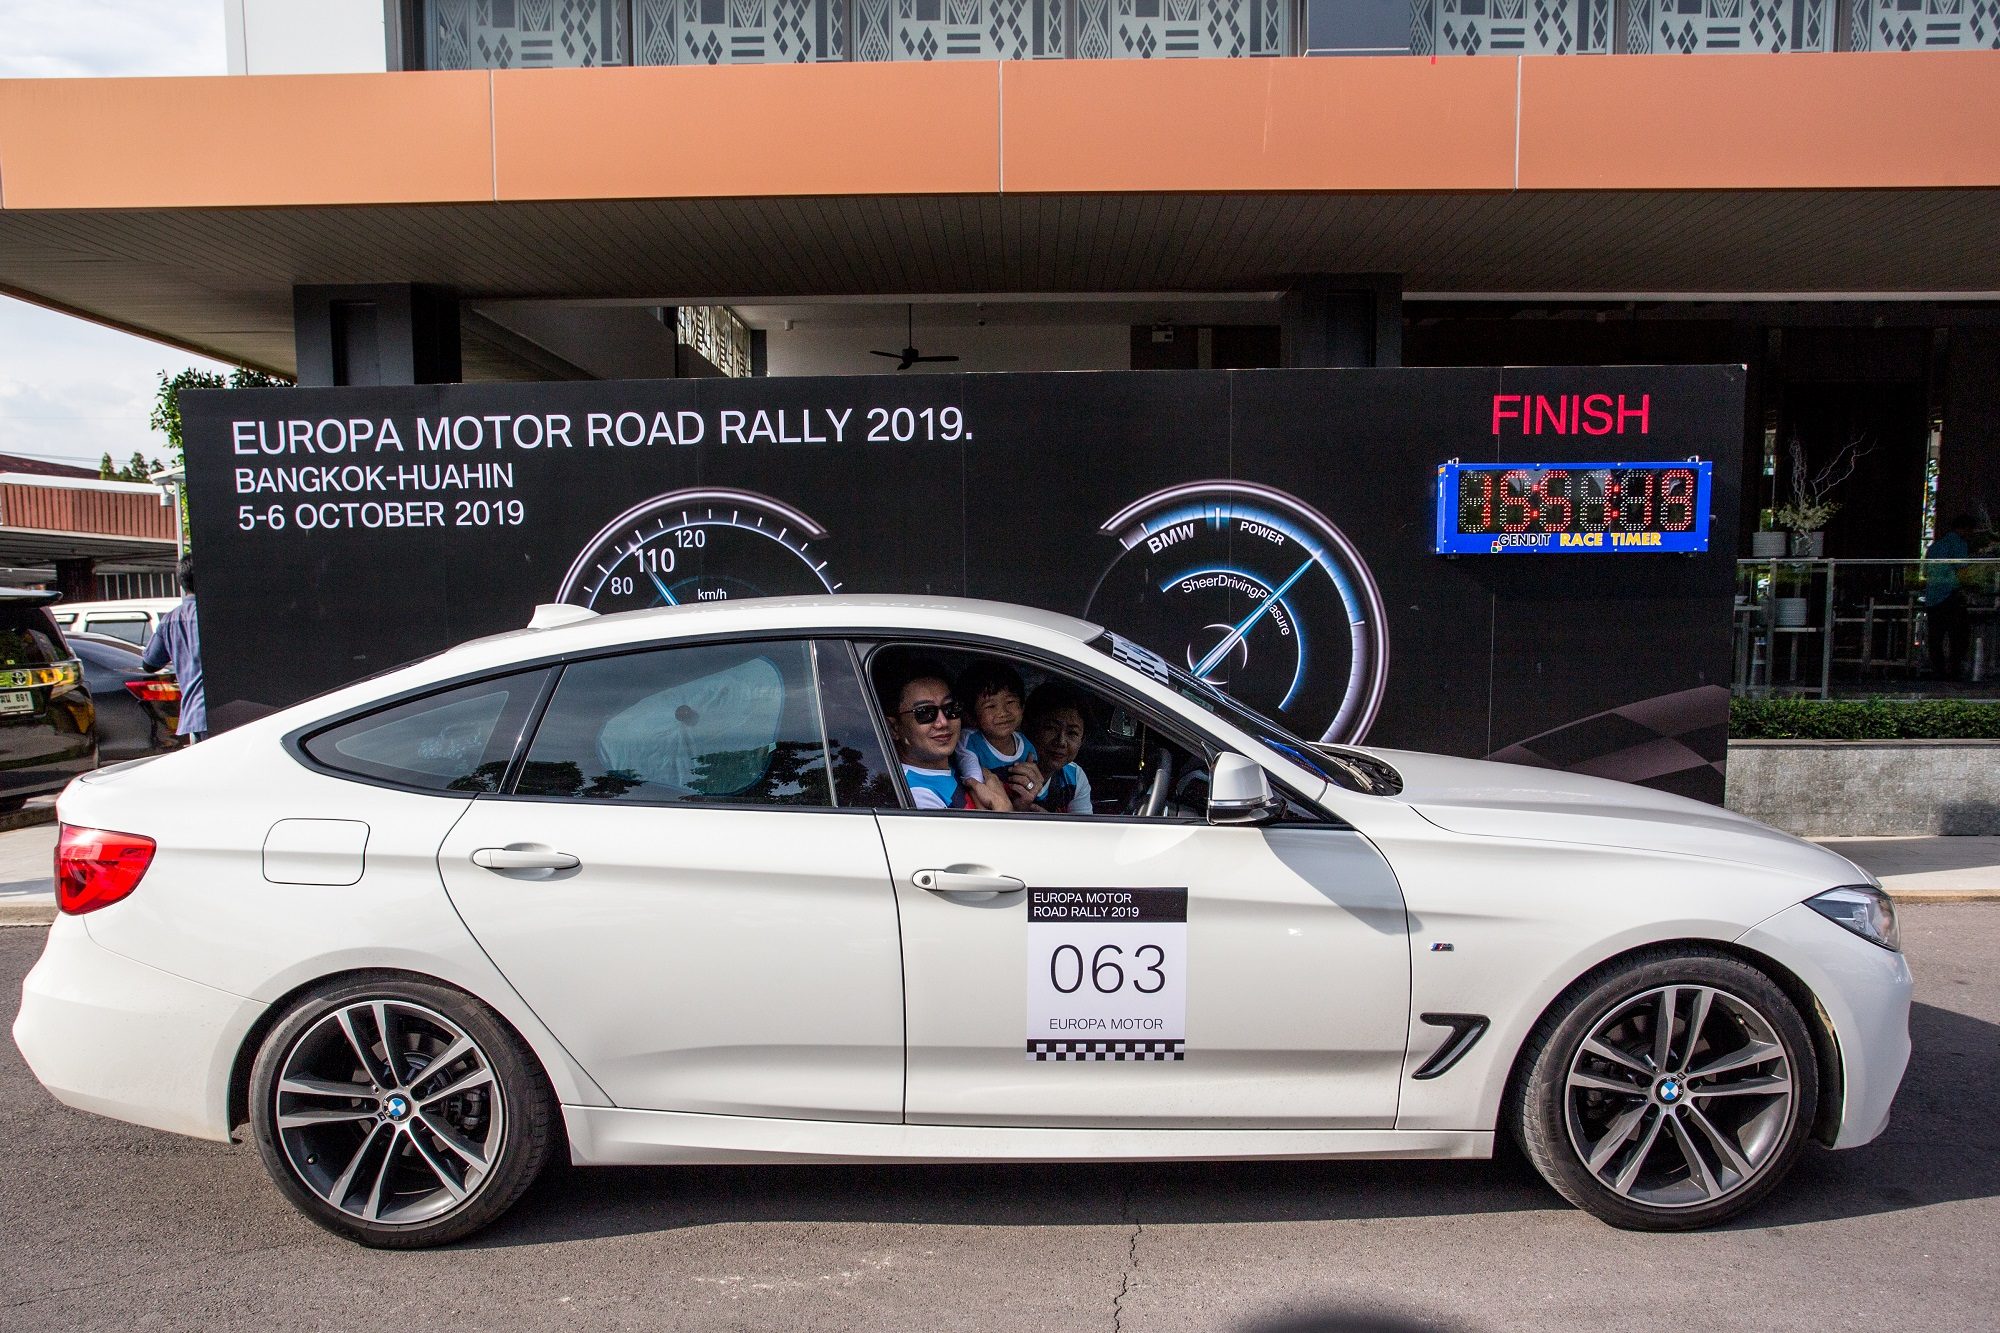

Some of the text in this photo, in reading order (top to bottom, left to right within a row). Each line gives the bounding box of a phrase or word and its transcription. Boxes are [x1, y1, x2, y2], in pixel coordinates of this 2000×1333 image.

[1492, 394, 1650, 435] FINISH
[232, 406, 973, 455] EUROPA MOTOR ROAD RALLY 2019.
[235, 462, 514, 494] BANGKOK-HUAHIN
[238, 499, 525, 531] 5-6 OCTOBER 2019
[674, 529, 706, 548] 120
[1147, 523, 1195, 554] BMW
[1240, 521, 1286, 546] POWER
[1498, 531, 1662, 548] GENDIT RACE TIMER
[635, 548, 675, 573] 110
[611, 576, 634, 595] 80
[697, 588, 728, 601] km/h
[1033, 892, 1132, 904] EUROPA MOTOR
[1033, 906, 1140, 918] ROAD RALLY 2019
[1050, 944, 1166, 994] 063
[1049, 1018, 1163, 1030] EUROPA MOTOR
